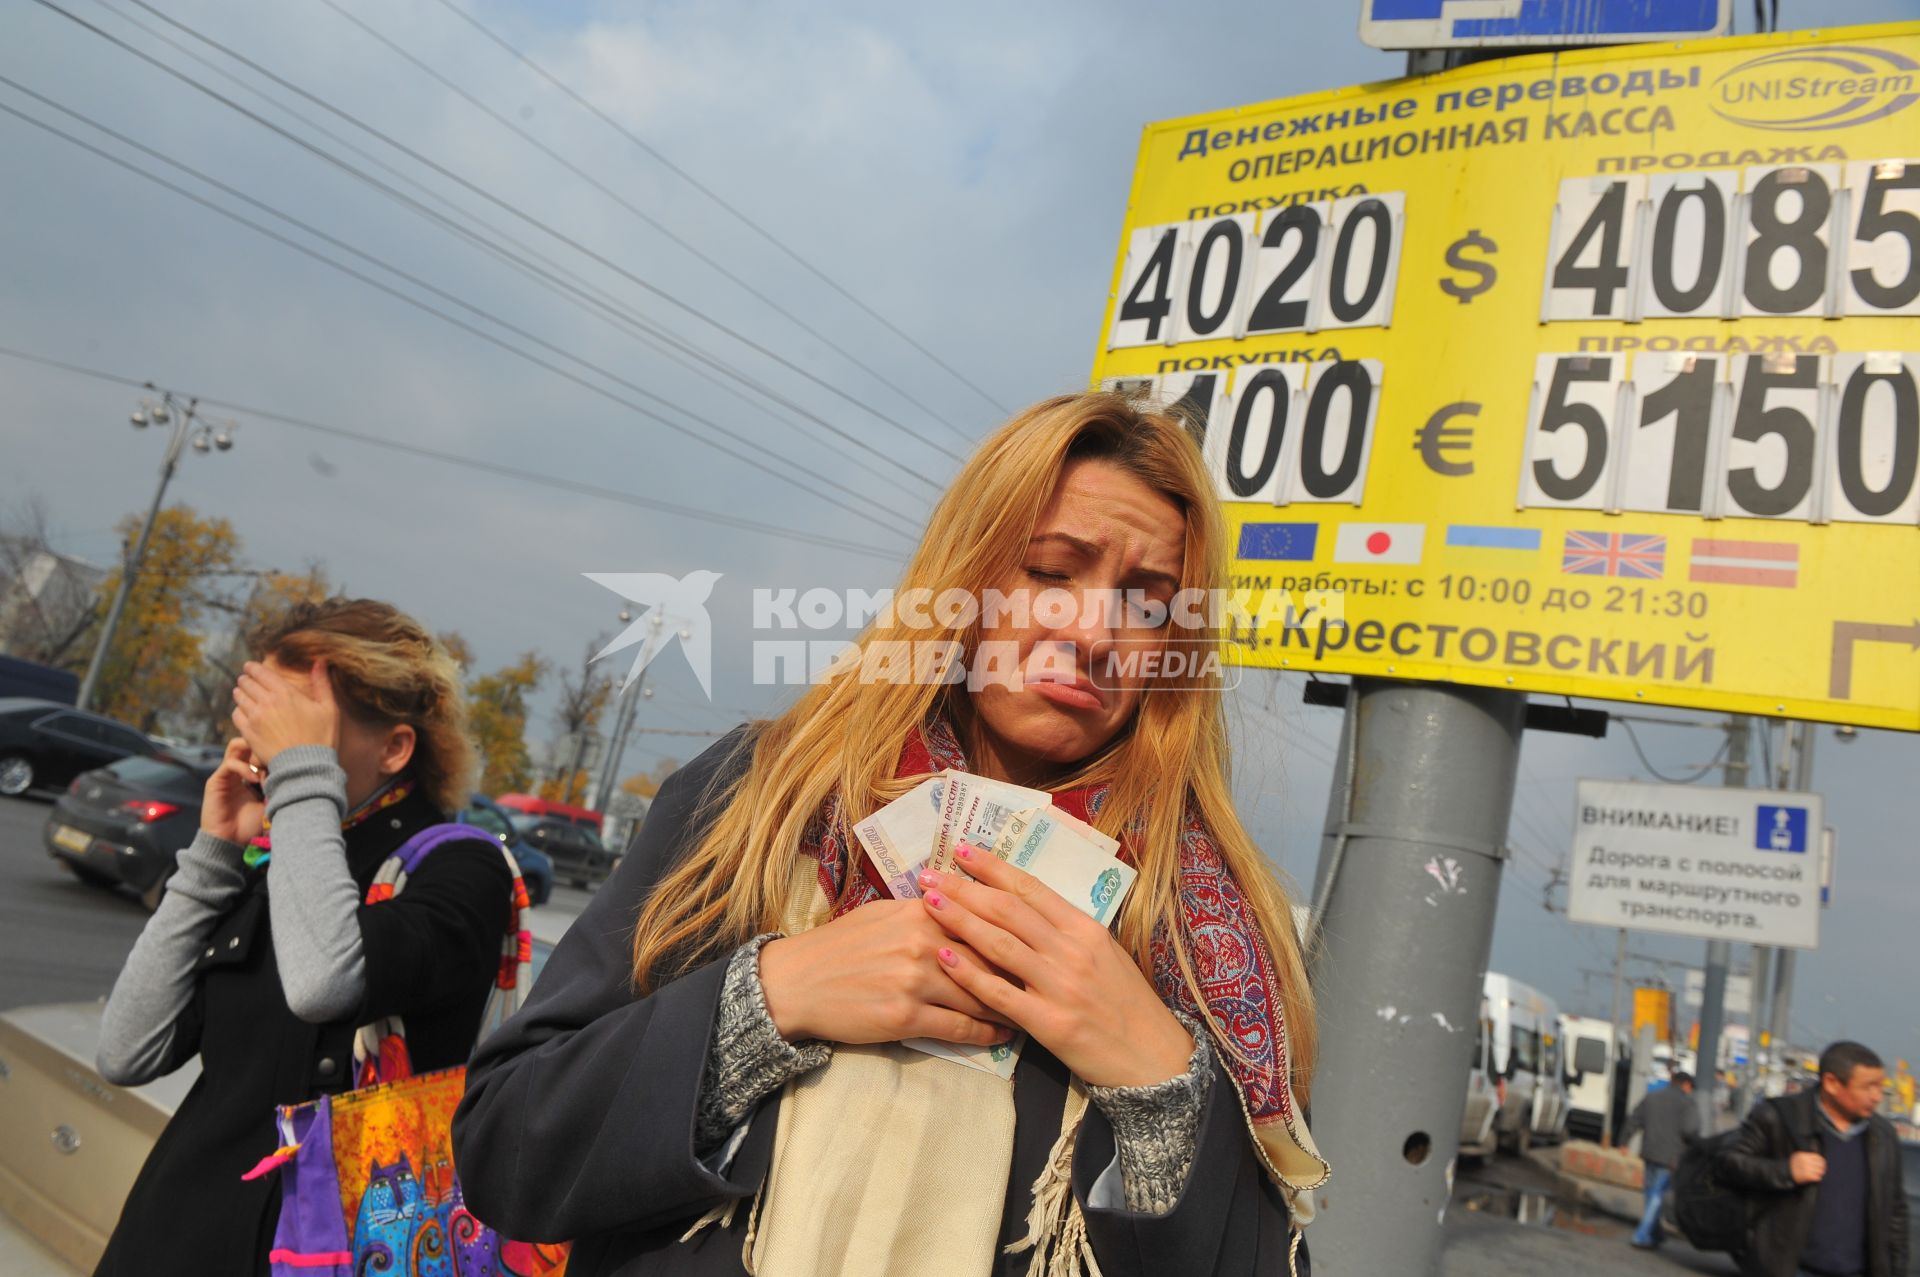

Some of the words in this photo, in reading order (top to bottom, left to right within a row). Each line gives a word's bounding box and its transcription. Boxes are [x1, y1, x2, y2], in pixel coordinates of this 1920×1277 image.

[1721, 74, 1914, 104] UNIStream
[1177, 97, 1418, 161] Денежные
[1434, 65, 1702, 113] переводы
[1228, 116, 1529, 184] ОПЕРАЦИОННАЯ
[1543, 105, 1676, 141] КАССА
[1596, 144, 1848, 173] ПРОДАЖА
[1187, 182, 1370, 221] ПОКУПКА
[1119, 199, 1392, 341] 4020
[1438, 228, 1499, 305] $
[1552, 165, 1920, 317] 4085
[1157, 346, 1343, 373] ПОКУПКА
[1577, 335, 1839, 353] ПРОДАЖА
[1113, 360, 1373, 498] 100
[1413, 402, 1482, 478] €
[1531, 354, 1919, 516] 5150
[1231, 574, 1272, 592] им
[1280, 571, 1398, 597] работы:
[1405, 578, 1425, 598] с
[1440, 574, 1532, 604] 10:00
[1541, 588, 1592, 612] до
[1605, 586, 1709, 620] 21:30
[1582, 805, 1740, 836] ВНИМАНИЕ!
[1587, 845, 1671, 871] Дорога
[1677, 857, 1692, 872] с
[1697, 859, 1803, 882] полосой
[1587, 873, 1632, 891] для
[1639, 878, 1801, 908] маршрутного
[1619, 900, 1765, 930] транспорта.
